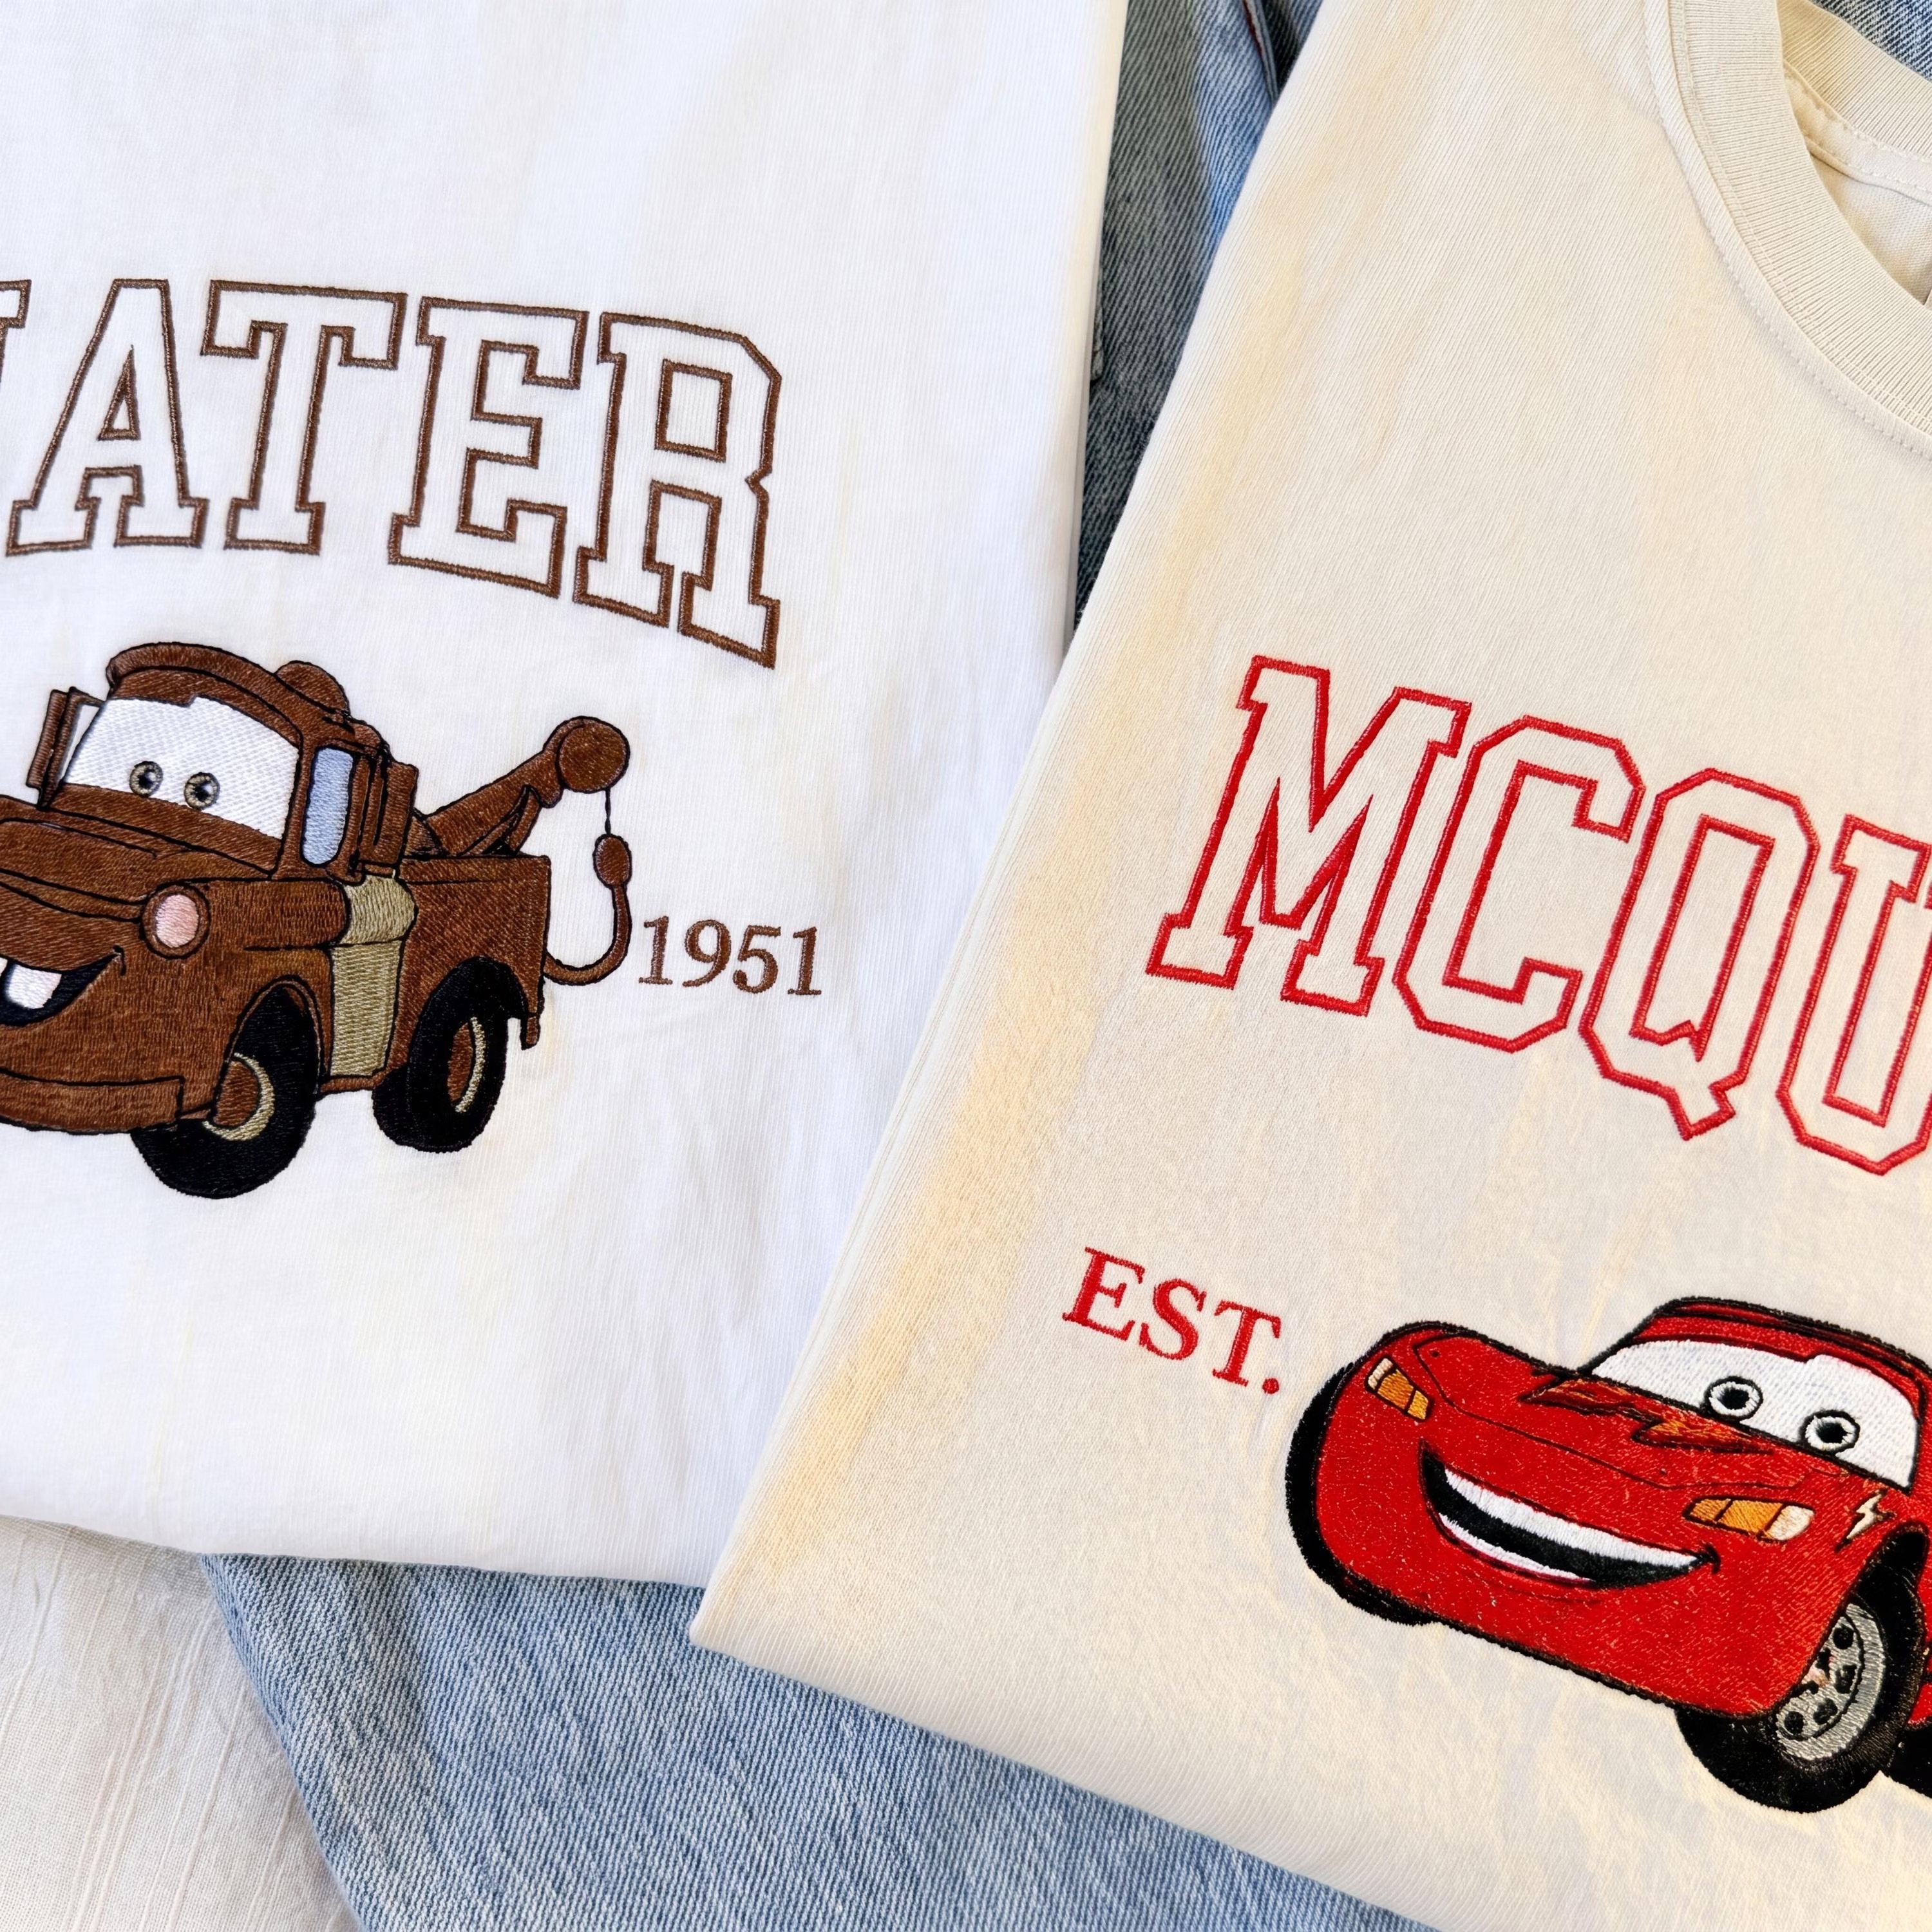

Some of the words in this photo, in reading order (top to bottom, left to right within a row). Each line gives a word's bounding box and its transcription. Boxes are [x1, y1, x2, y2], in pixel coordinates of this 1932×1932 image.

[0, 279, 782, 668] ATER
[639, 916, 822, 997] 1951
[1146, 655, 1932, 1176] MCQU
[1063, 1247, 1281, 1394] EST.
